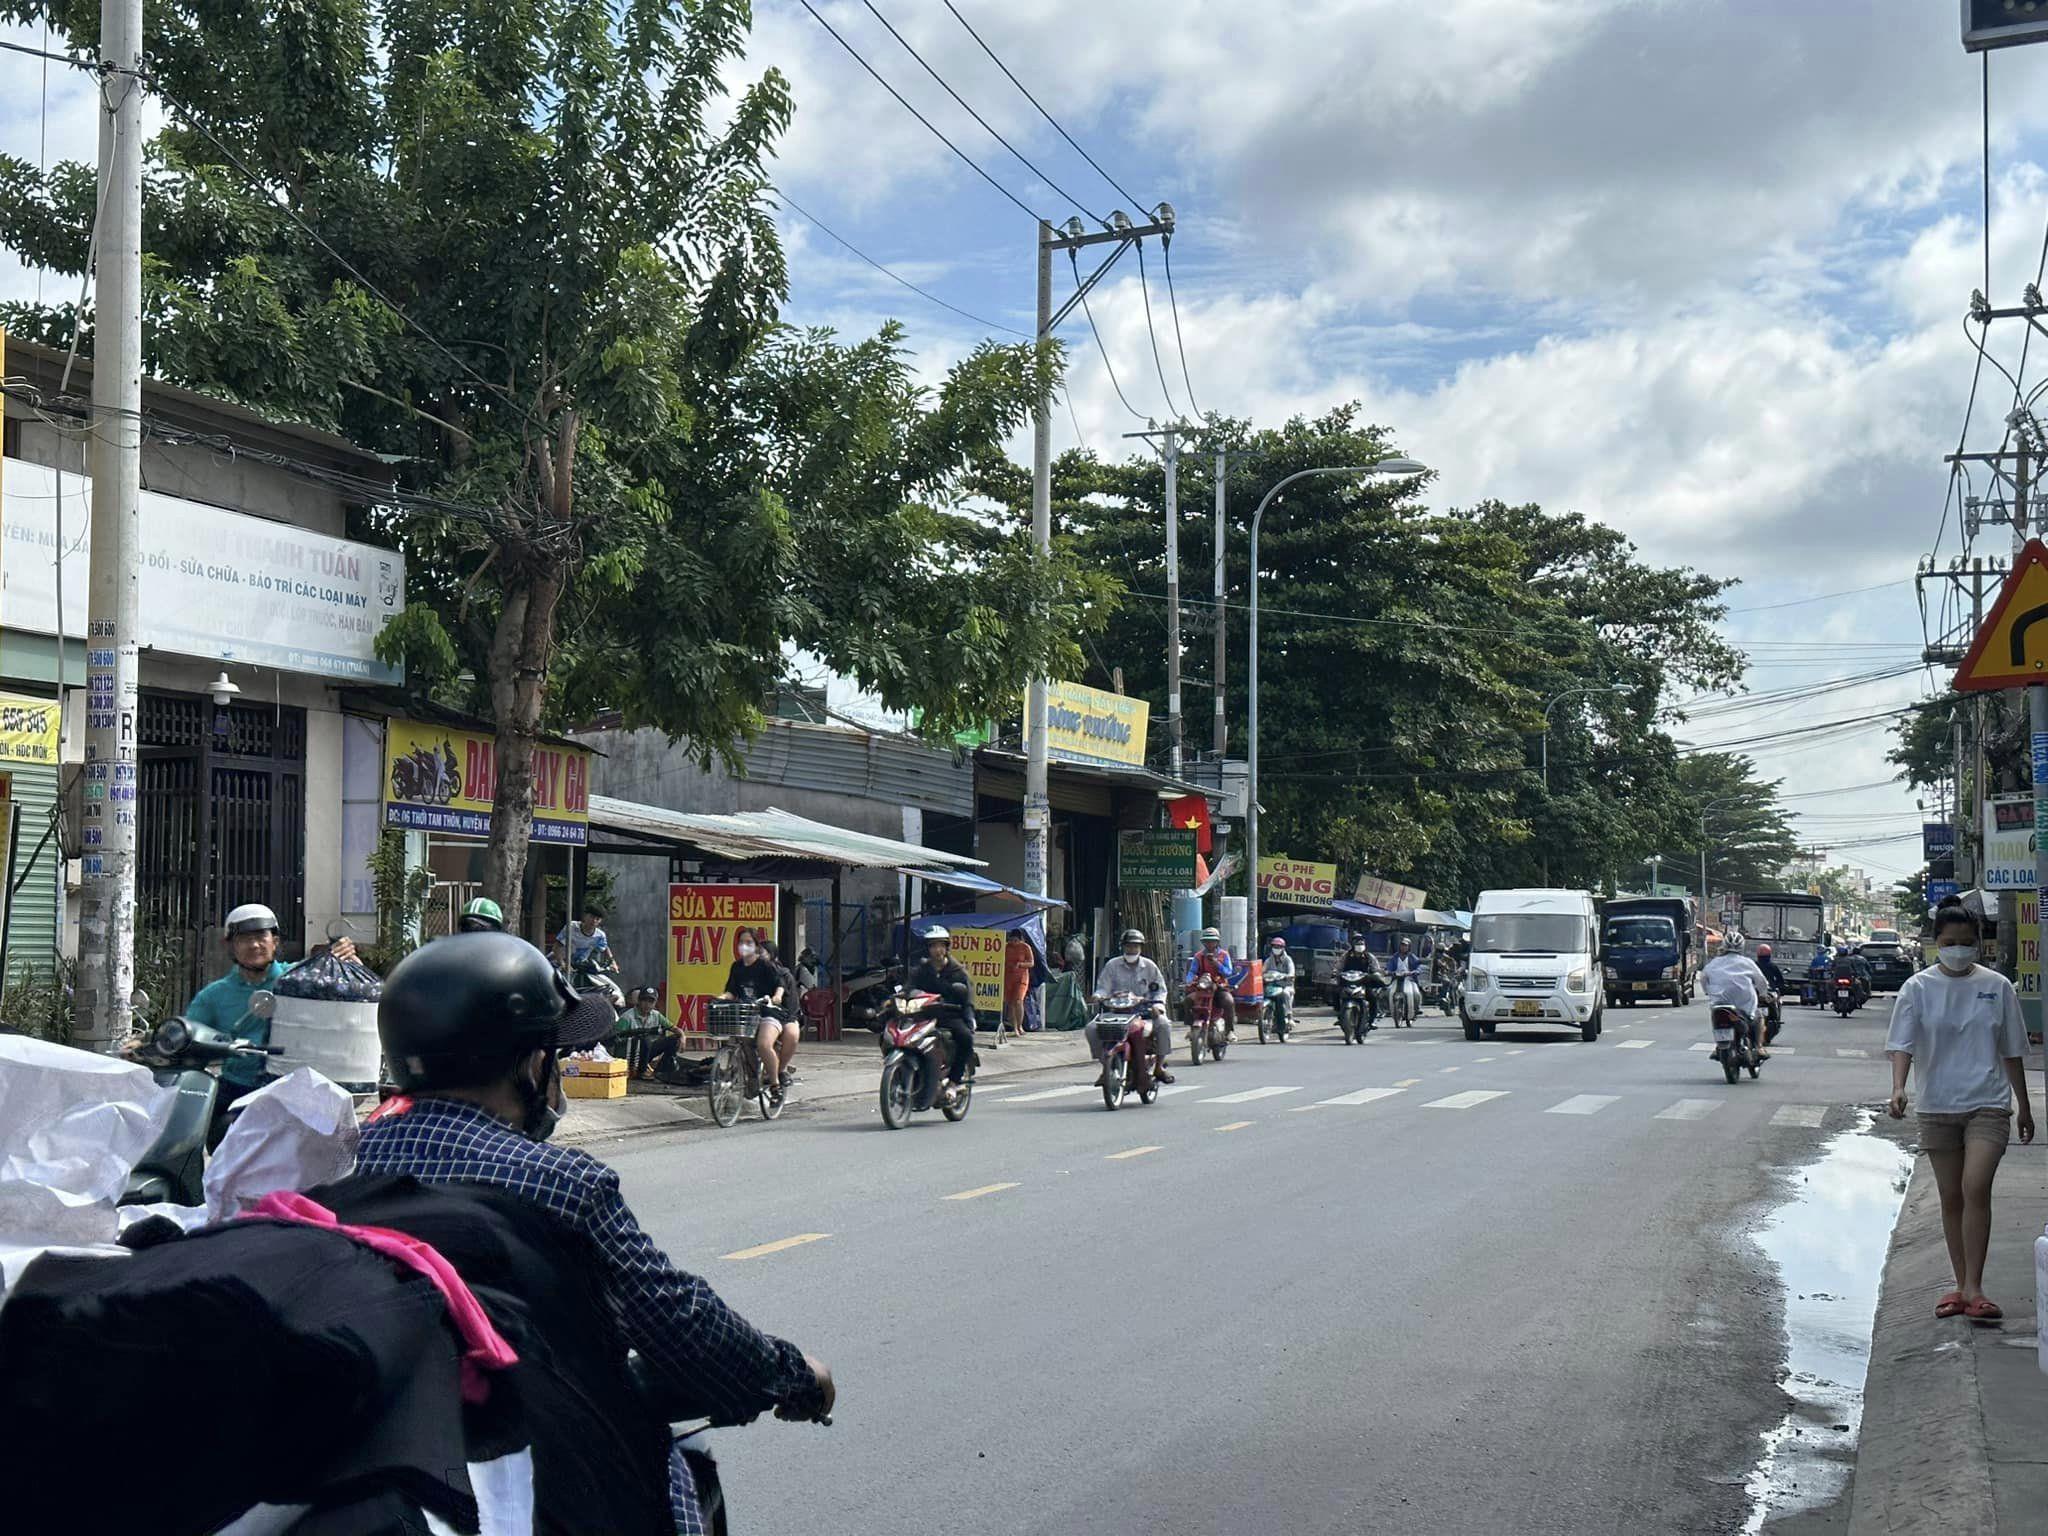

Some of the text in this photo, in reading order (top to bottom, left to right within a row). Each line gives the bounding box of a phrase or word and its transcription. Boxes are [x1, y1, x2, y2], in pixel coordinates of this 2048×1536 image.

[311, 544, 361, 582] TUẤN
[180, 556, 204, 578] SỬA
[208, 564, 240, 584] CHỮA
[249, 570, 272, 590] BẢO
[295, 581, 317, 598] CÁC
[319, 587, 343, 607] LOẠI
[346, 592, 368, 609] MÁY
[26, 708, 48, 734] 345
[121, 713, 133, 740] R
[32, 742, 48, 759] MÔN
[564, 753, 586, 814] GA
[428, 812, 442, 828] TAM
[462, 813, 483, 832] HUYỆN
[1986, 866, 2009, 884] CÁC
[671, 887, 772, 919] SỬA XE HONDA
[1270, 891, 1292, 902] KHAI
[672, 925, 727, 965] TAY
[951, 932, 1002, 953] BÚN BÒ
[971, 956, 1001, 977] TIẾU
[975, 982, 1000, 997] CANH
